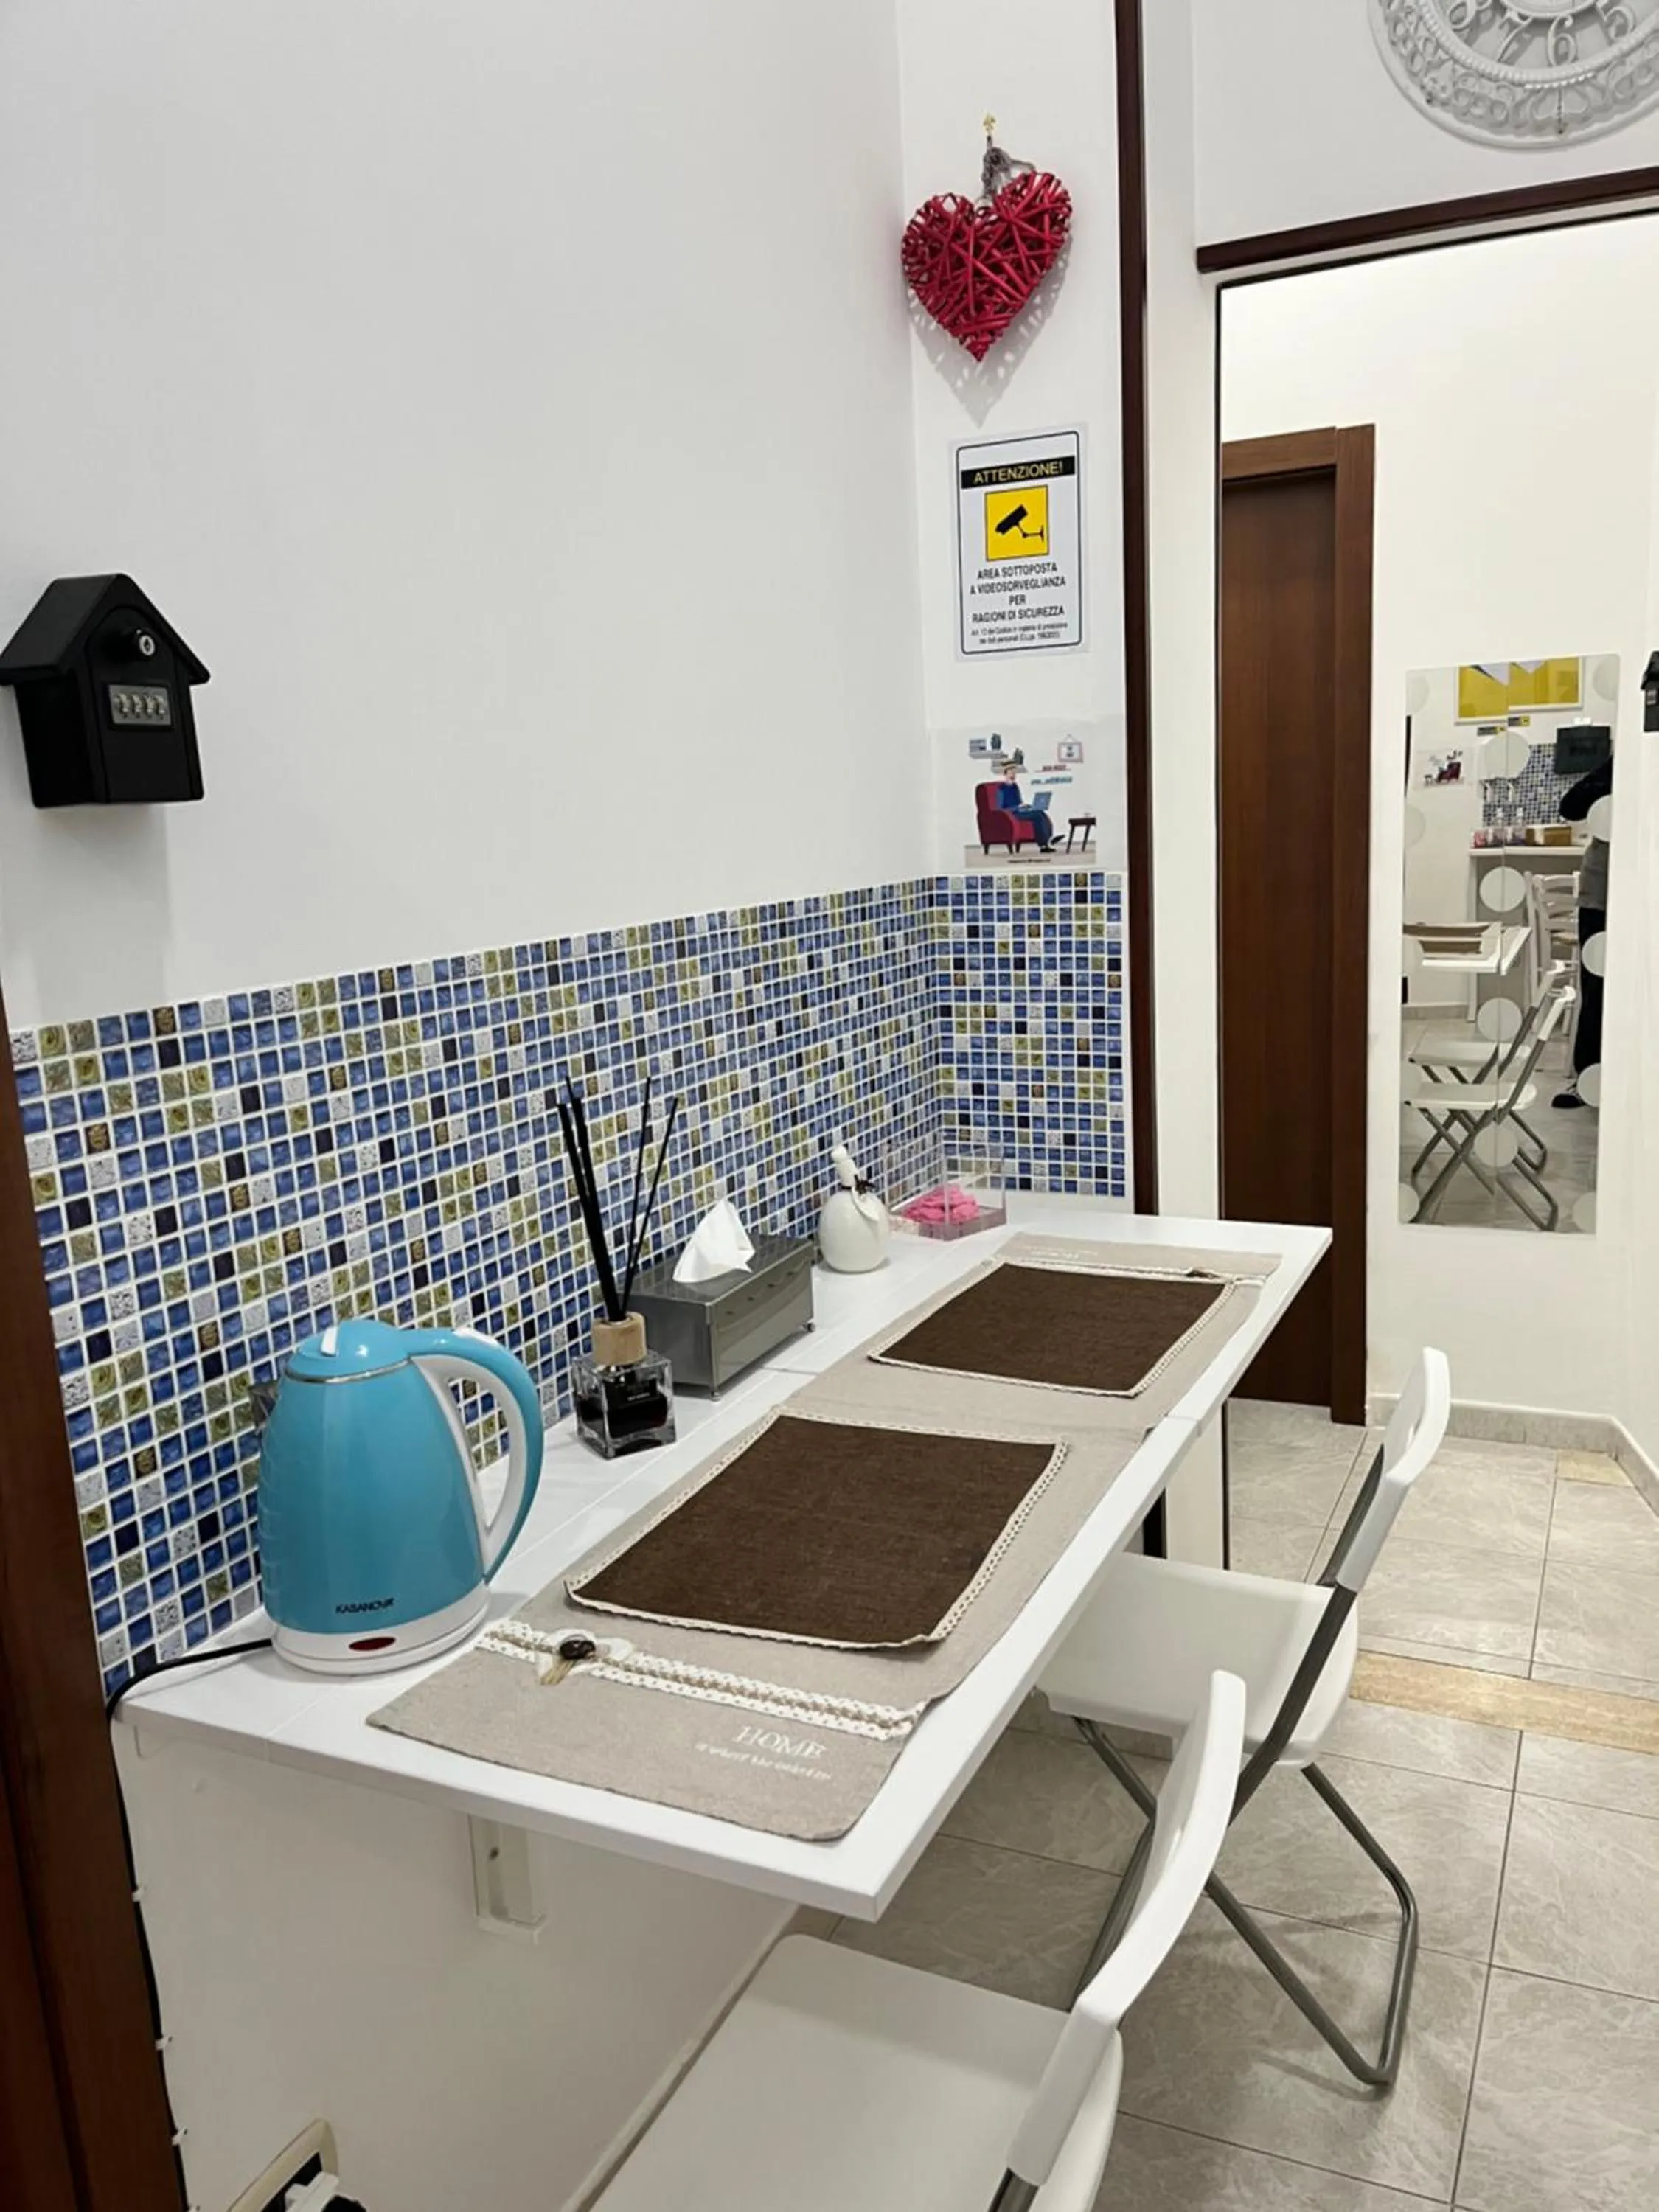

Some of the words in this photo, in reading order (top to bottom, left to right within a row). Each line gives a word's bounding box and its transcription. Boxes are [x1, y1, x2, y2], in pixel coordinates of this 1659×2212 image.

[973, 460, 1062, 484] ATTENZIONE!
[978, 568, 1000, 579] AREA
[1001, 562, 1057, 577] SOTTOPOSTA
[970, 585, 976, 594] A
[978, 576, 1066, 594] VIDEOSORVEGLIANZA
[1009, 594, 1026, 605] PER
[972, 611, 1006, 622] RAGIONI
[1008, 610, 1016, 620] DI
[1018, 605, 1064, 619] SICUREZZA
[335, 1597, 394, 1614] KASANOVA
[732, 1726, 827, 1758] HOME
